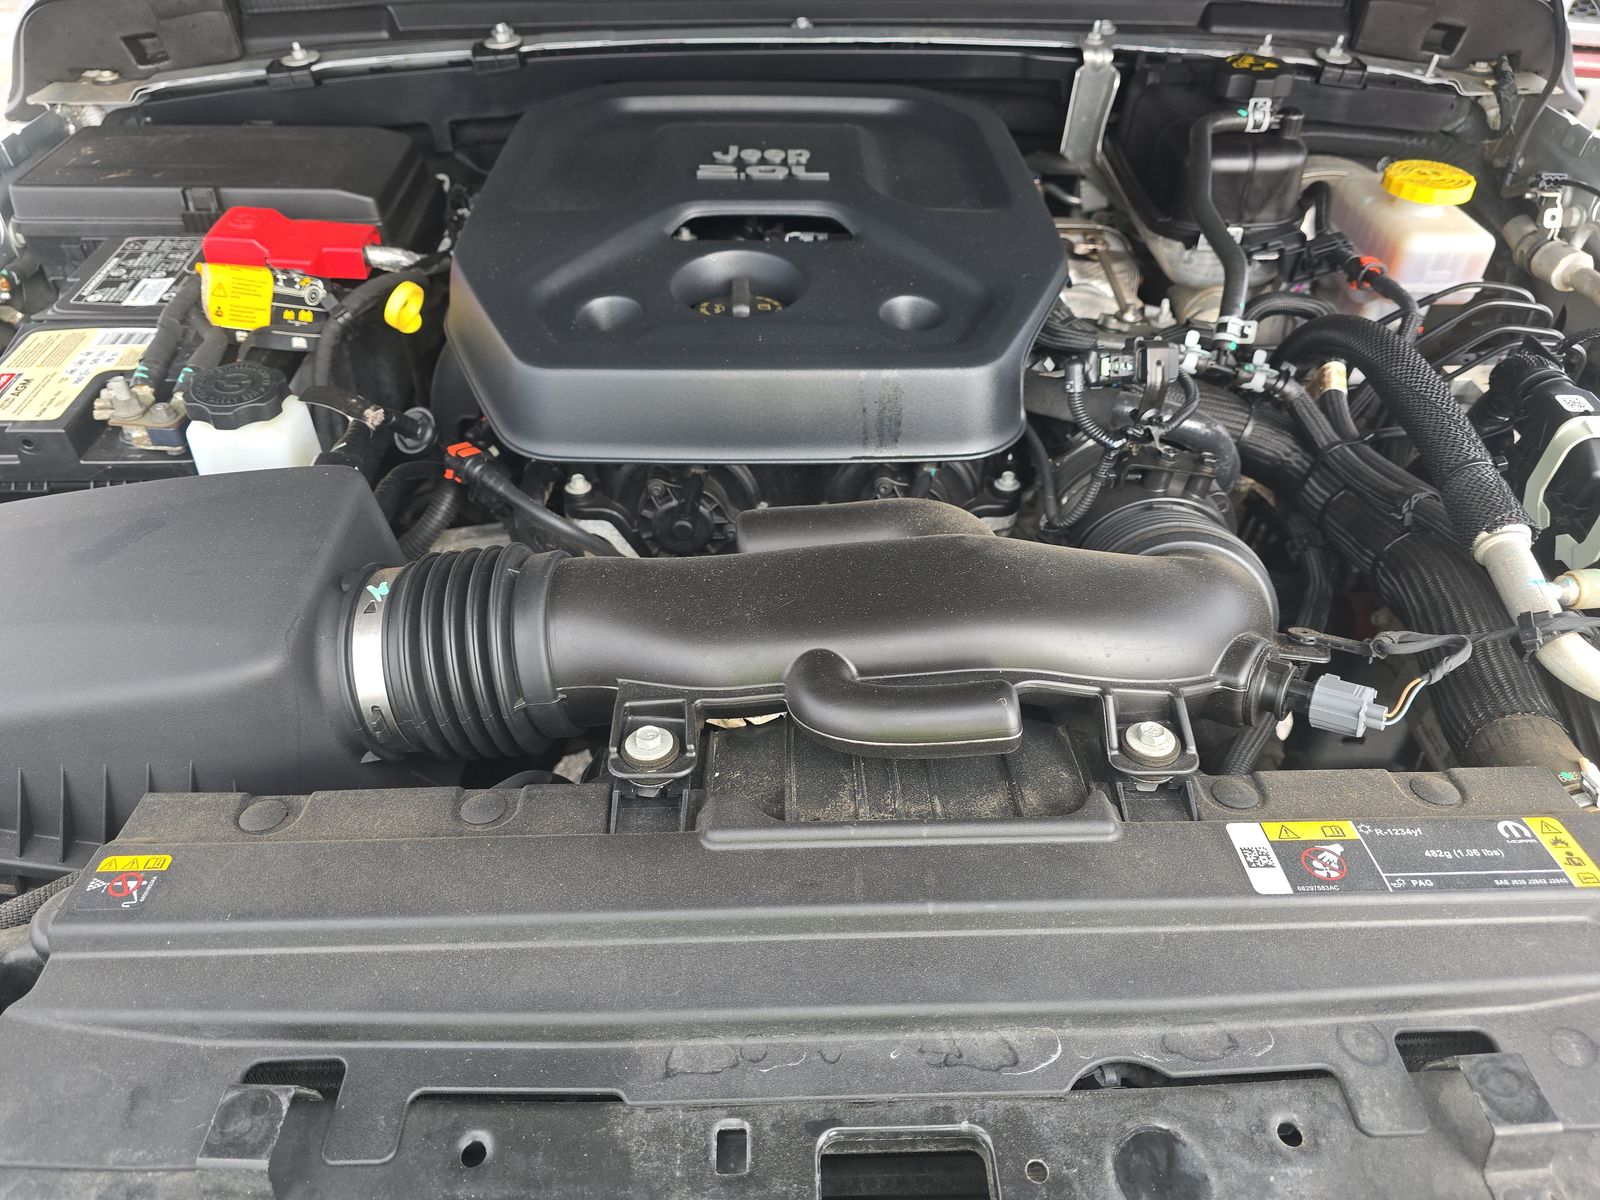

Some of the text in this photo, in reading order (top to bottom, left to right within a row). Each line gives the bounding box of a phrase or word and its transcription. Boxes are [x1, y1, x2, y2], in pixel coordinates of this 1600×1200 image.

[15, 378, 33, 397] AGM
[1374, 827, 1423, 837] R-1234yf
[1424, 849, 1453, 859] 482g
[1481, 848, 1505, 858] lbs)
[1410, 879, 1434, 887] PAG
